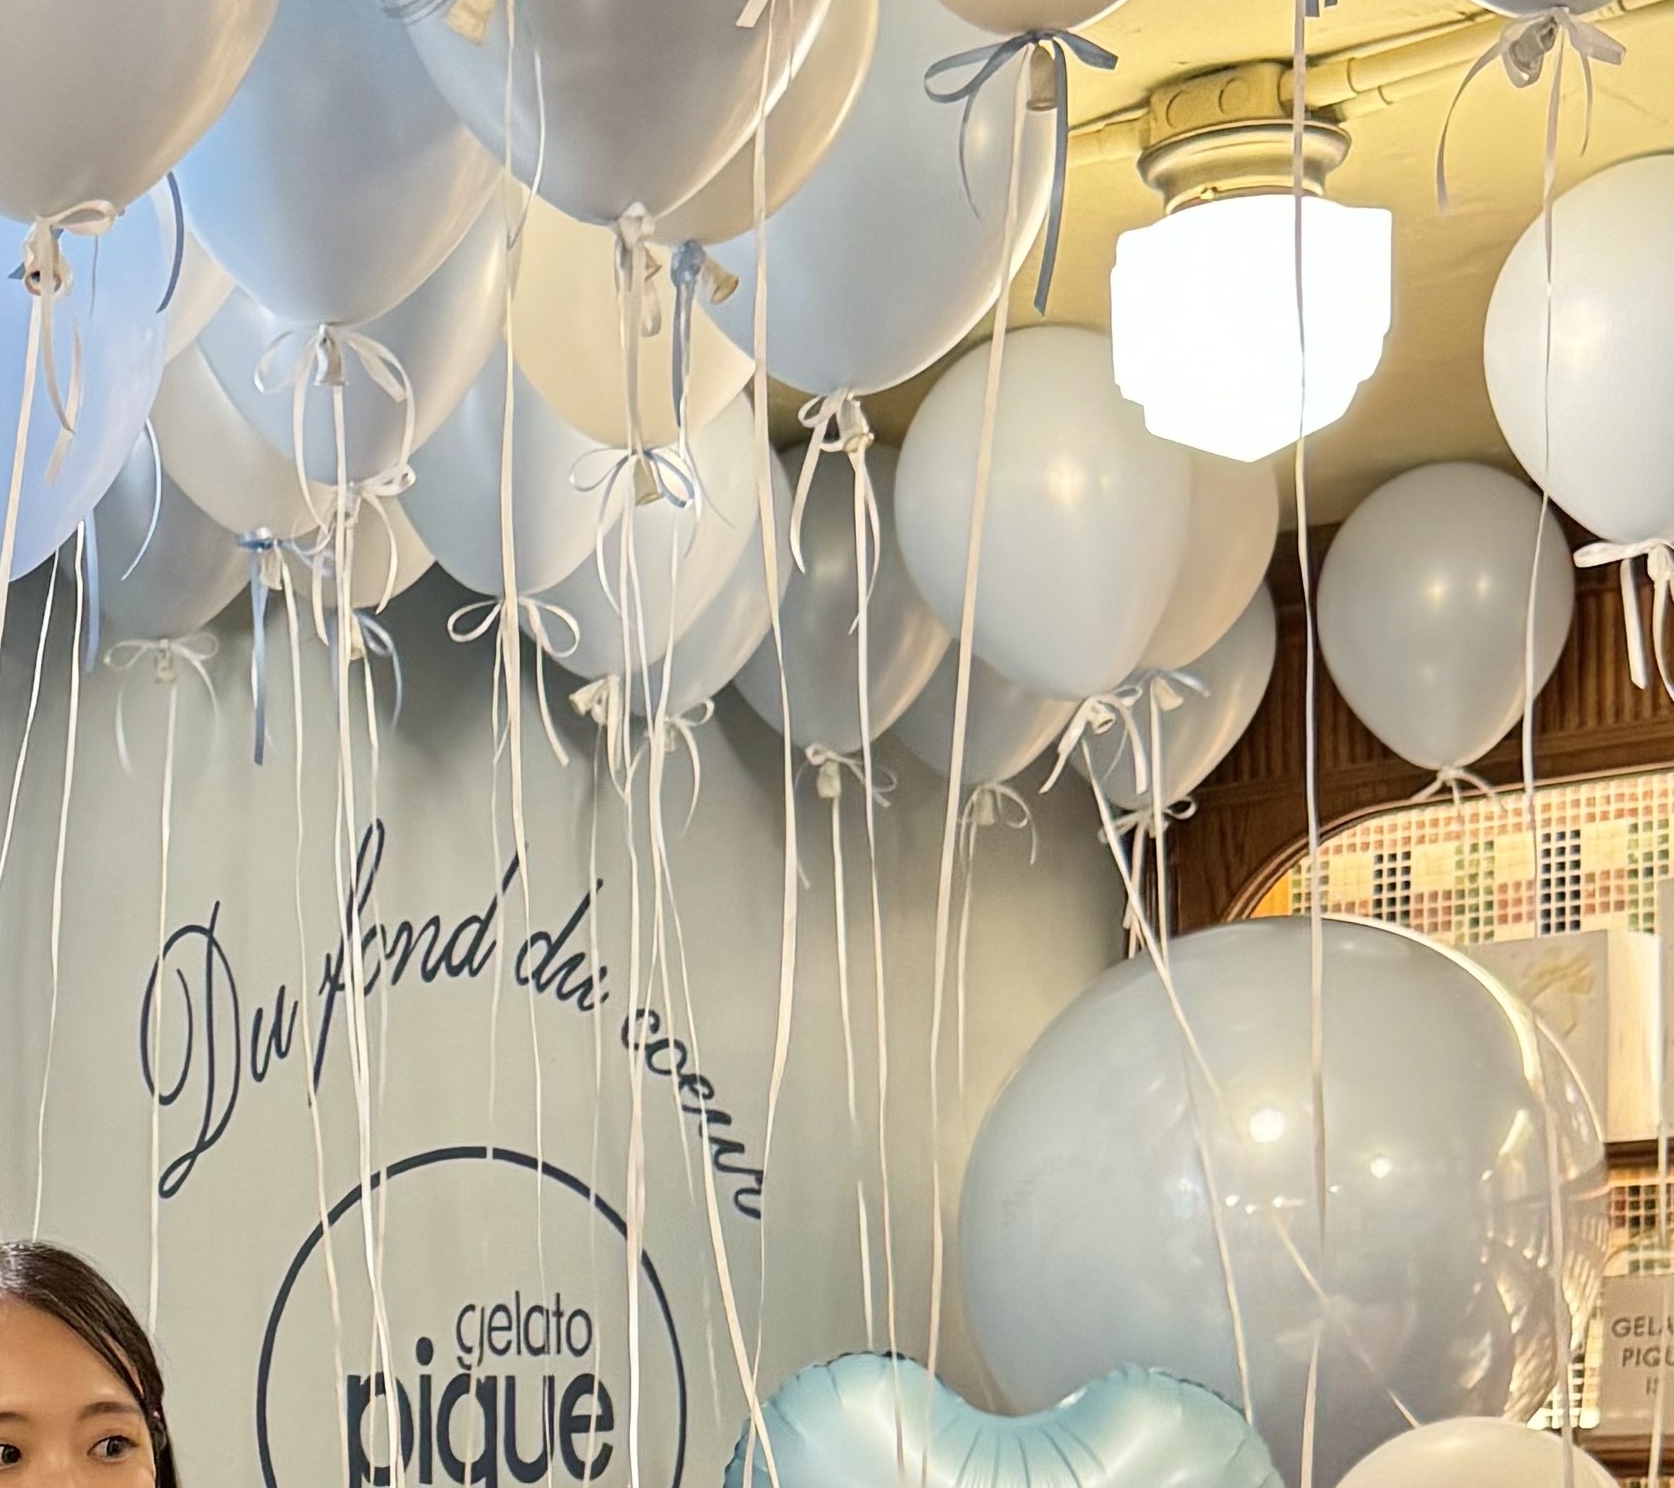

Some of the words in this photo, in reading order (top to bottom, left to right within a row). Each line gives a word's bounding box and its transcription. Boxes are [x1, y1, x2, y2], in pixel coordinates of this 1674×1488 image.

[140, 900, 299, 1199] Du
[307, 818, 529, 1108] fond
[515, 877, 610, 1013] du
[456, 1290, 593, 1371] gelato
